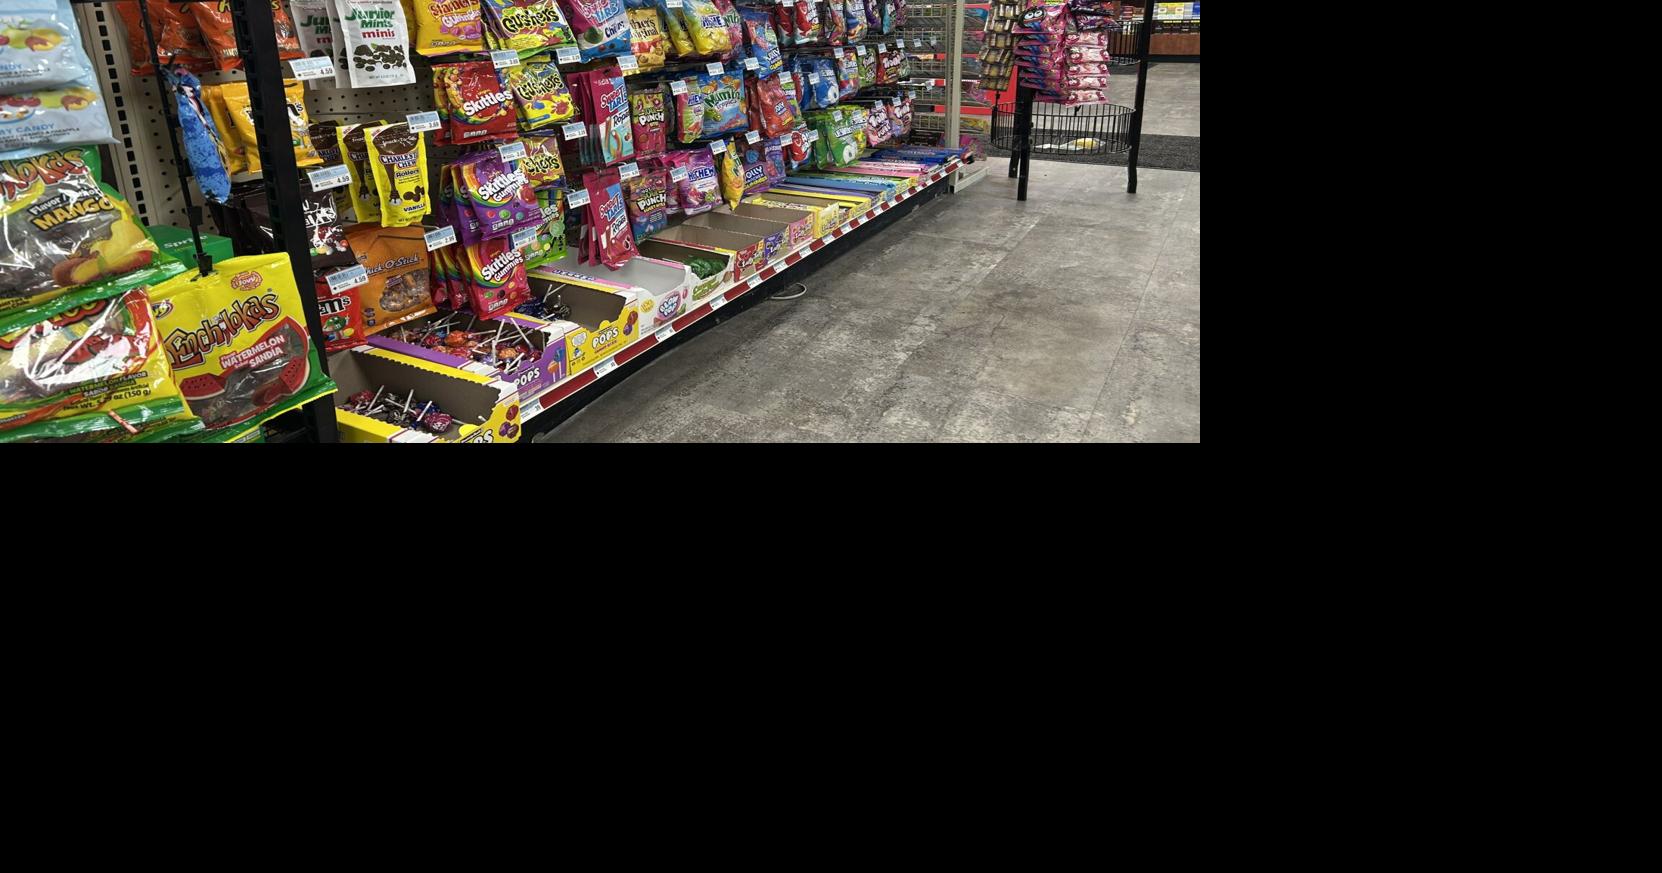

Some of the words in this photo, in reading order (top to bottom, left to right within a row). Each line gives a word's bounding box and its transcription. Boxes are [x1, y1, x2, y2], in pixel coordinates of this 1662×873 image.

[345, 8, 395, 21] Junior
[360, 18, 394, 29] Mints
[362, 29, 396, 40] minis
[463, 90, 513, 116] Skittles
[29, 199, 61, 217] Flavor
[32, 196, 114, 231] MANGO
[481, 248, 522, 282] Skittles
[494, 256, 525, 282] Gummies
[592, 327, 620, 350] POPS
[222, 334, 286, 370] WATERMELON
[514, 367, 541, 388] POPS
